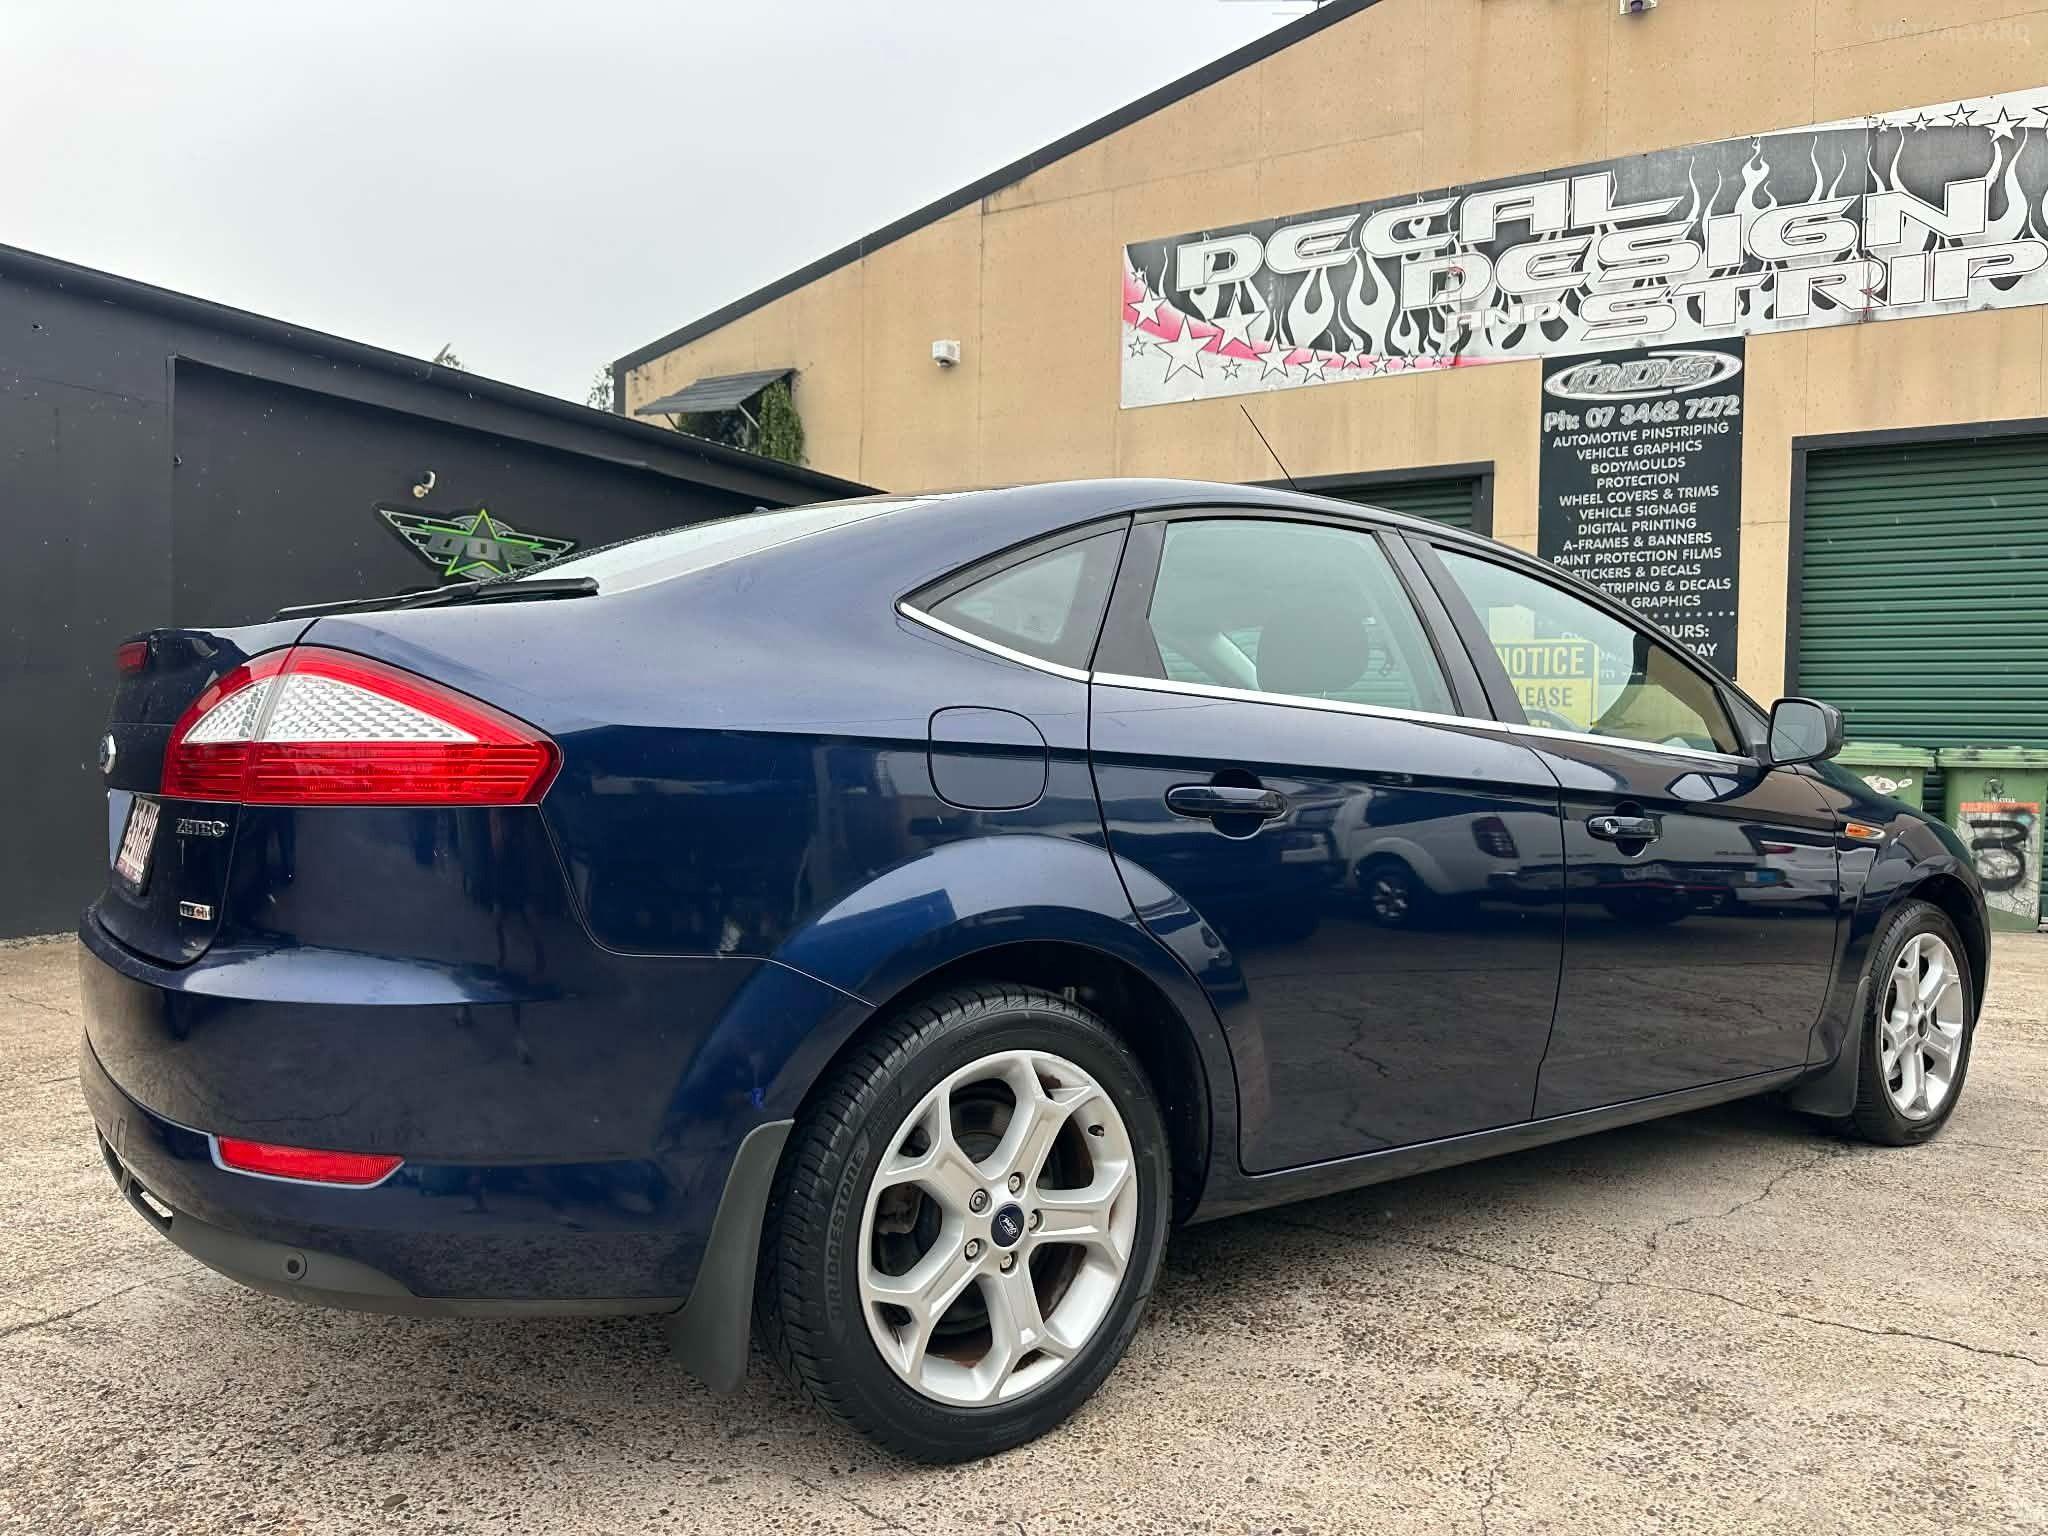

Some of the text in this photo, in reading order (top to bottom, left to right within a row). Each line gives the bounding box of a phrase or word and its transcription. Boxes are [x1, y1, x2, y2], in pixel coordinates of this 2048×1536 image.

[1176, 171, 1685, 292] DECAL
[1402, 178, 1988, 310] DESIGN
[1447, 239, 2048, 341] AND STRIP
[1585, 405, 1616, 429] 07
[1620, 400, 1680, 425] 3462
[1685, 394, 1740, 420] 7272
[1553, 422, 1729, 448] AUTOMOTIVE PINSTRIPING
[1576, 439, 1703, 461] VEHICLE GRAPHICS
[1591, 456, 1686, 474] BODYMOULDS
[1597, 473, 1680, 489] PROTECTION
[1559, 485, 1719, 507] WHEEL COVERS & TRIMS
[1579, 502, 1697, 521] VEHICLE SIGNAGE
[1578, 518, 1697, 536] DIGITAL PRINTING
[1563, 532, 1713, 552] A-FRAMES & BANNERS
[1553, 547, 1722, 566] PAINT PROTECTION FILMS
[1572, 564, 1701, 580] STICKERS & DECALS
[1665, 579, 1675, 592] &
[1679, 577, 1732, 591] DECALS
[1631, 594, 1701, 609] GRAPHICS
